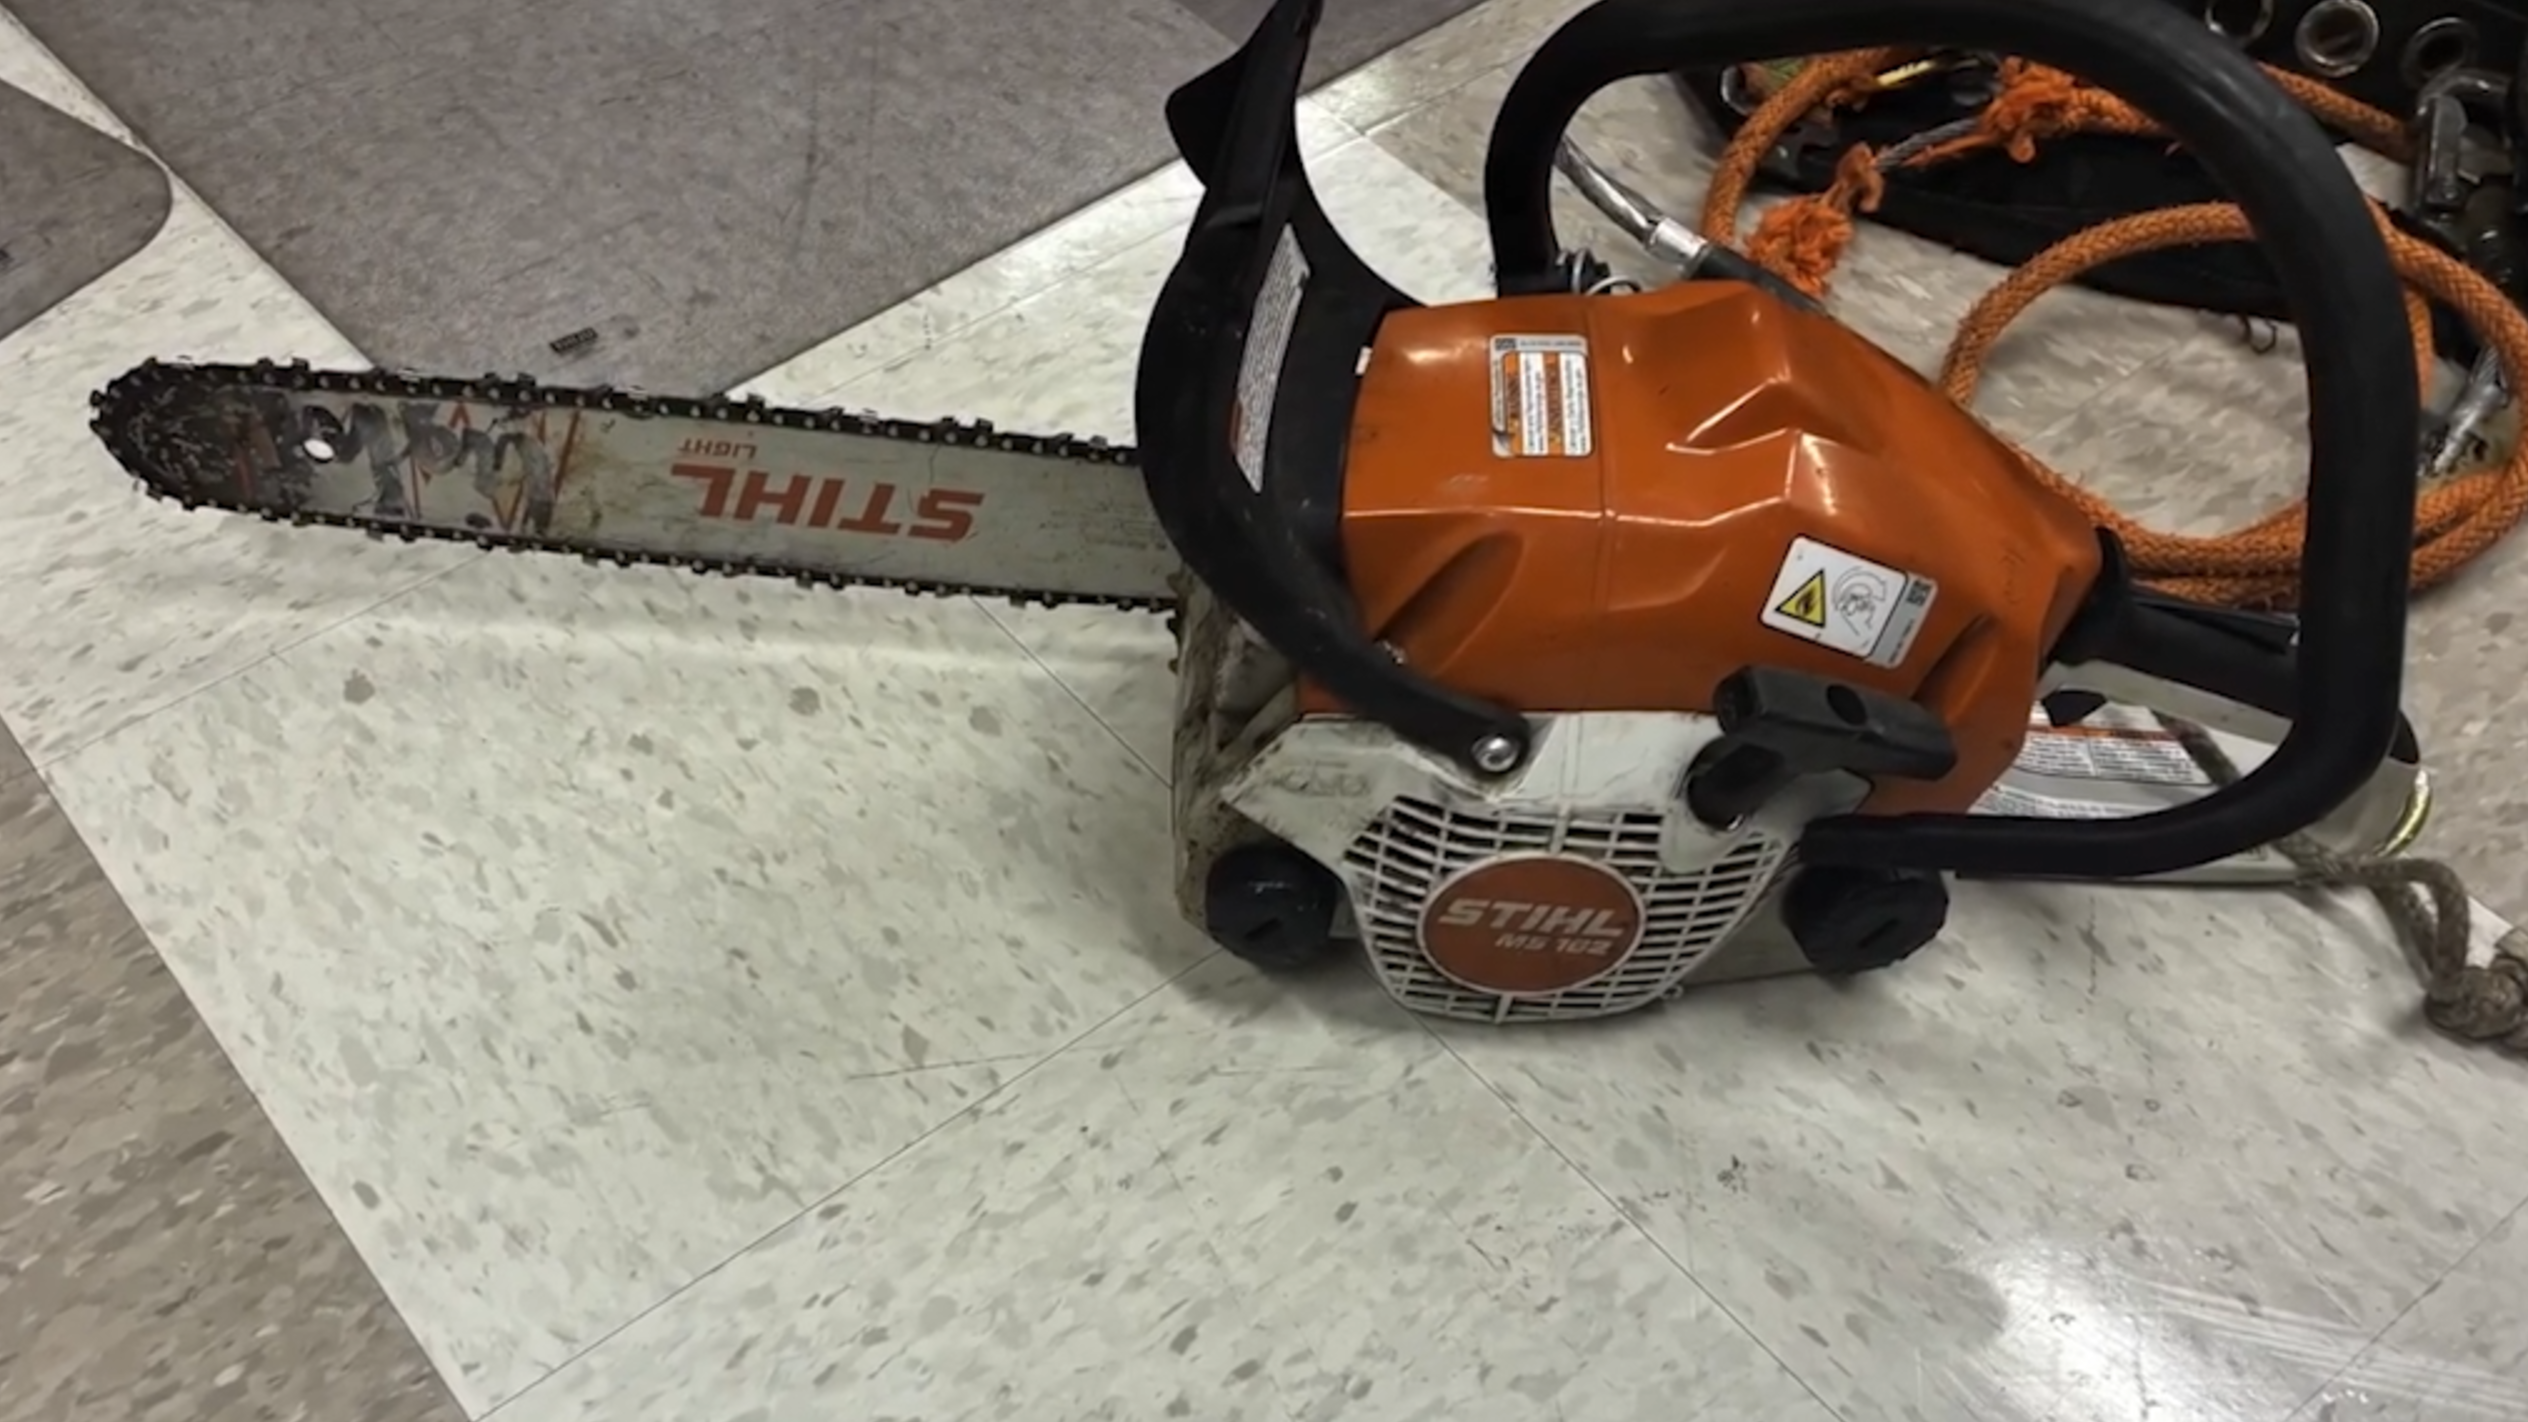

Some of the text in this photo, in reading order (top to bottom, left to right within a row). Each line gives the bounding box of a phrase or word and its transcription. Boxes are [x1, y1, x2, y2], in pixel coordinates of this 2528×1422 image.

[677, 439, 758, 460] LIGHT
[670, 463, 984, 542] STIHL
[1439, 898, 1623, 937] STIHL
[1495, 932, 1548, 951] MS
